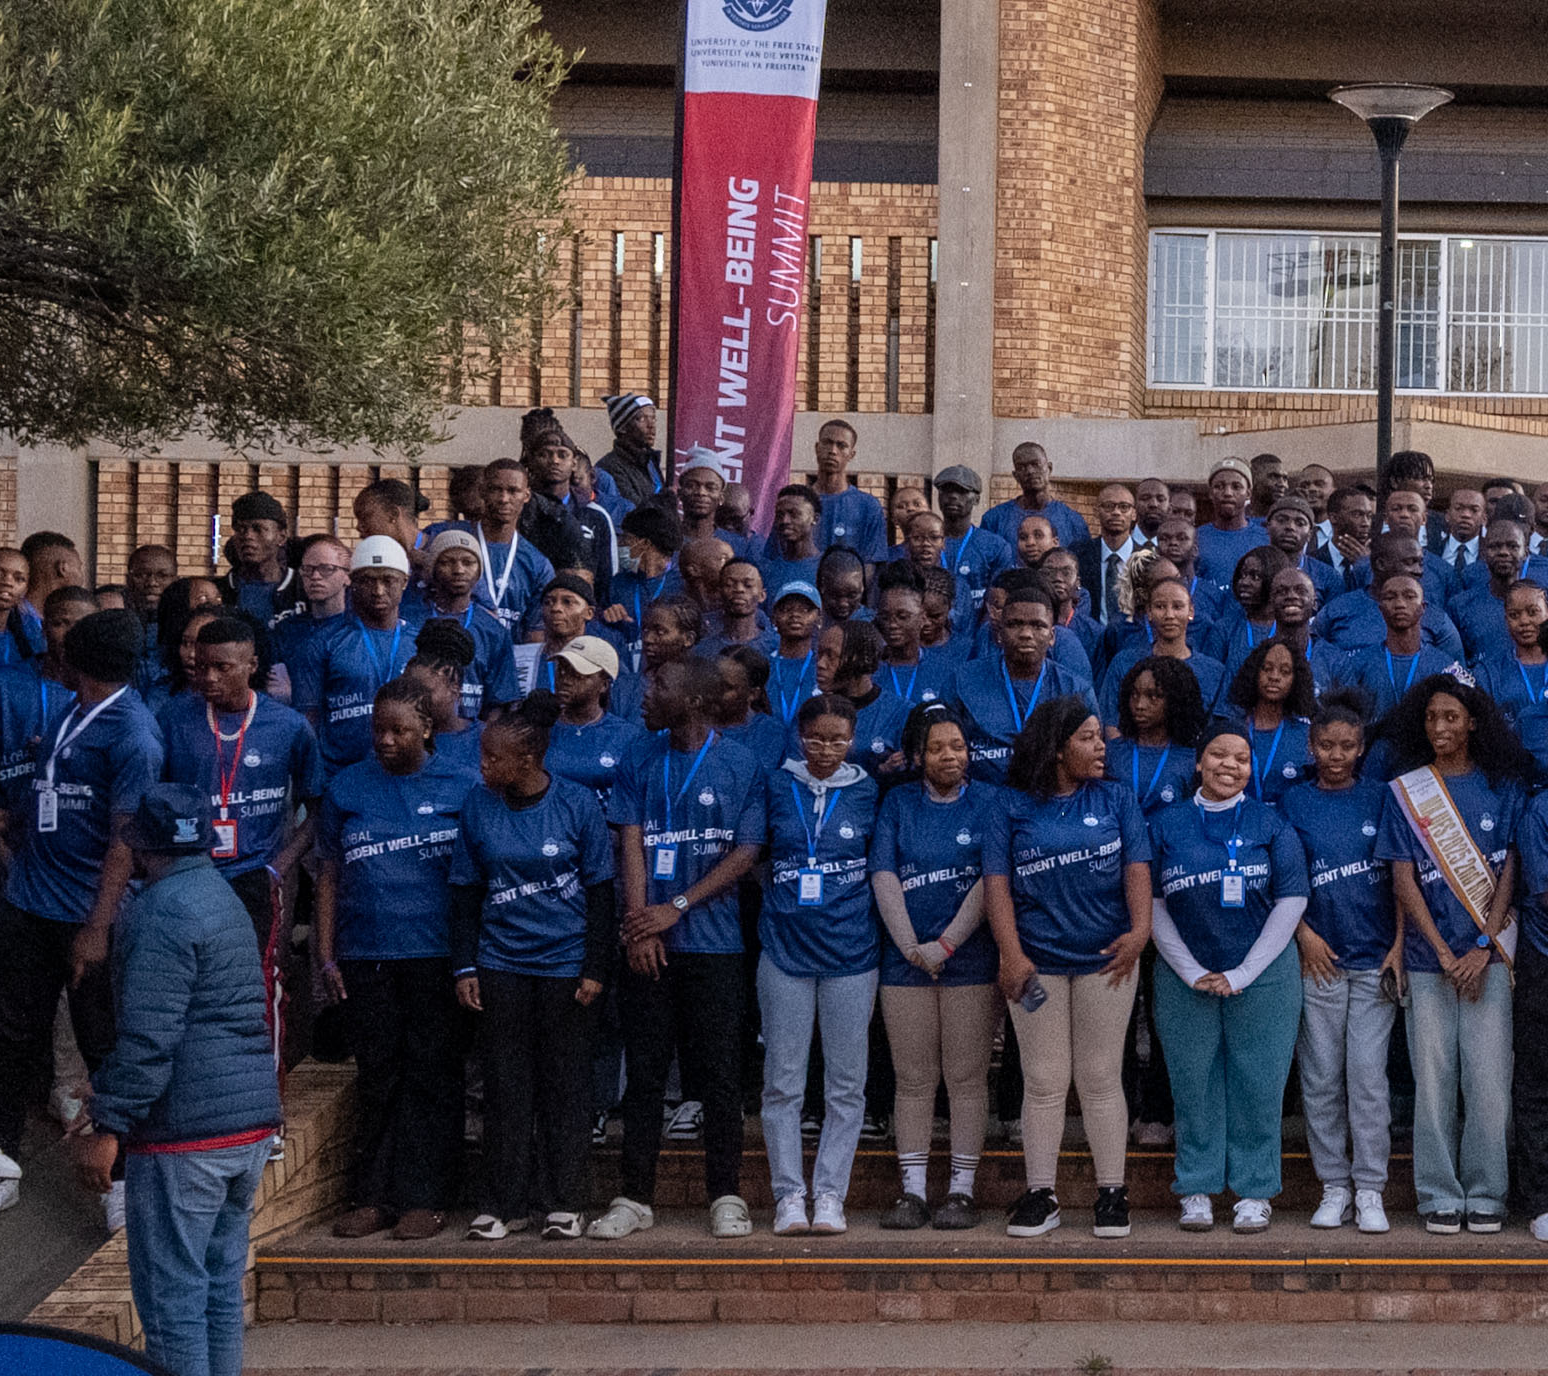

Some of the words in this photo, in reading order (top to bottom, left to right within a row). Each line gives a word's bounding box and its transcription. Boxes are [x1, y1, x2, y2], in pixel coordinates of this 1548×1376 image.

[691, 38, 738, 47] UNIVERSITY
[740, 39, 751, 47] OF
[754, 40, 770, 49] THE
[773, 41, 793, 50] FREE
[796, 42, 820, 54] STATE
[691, 48, 742, 57] UNIVERSITEIT
[745, 51, 761, 59] VAN
[763, 52, 777, 60] DIE
[752, 62, 763, 70] YA
[765, 63, 806, 72] FREISTATA
[766, 185, 805, 333] SUMMIT
[718, 176, 760, 407] WELL-BEING
